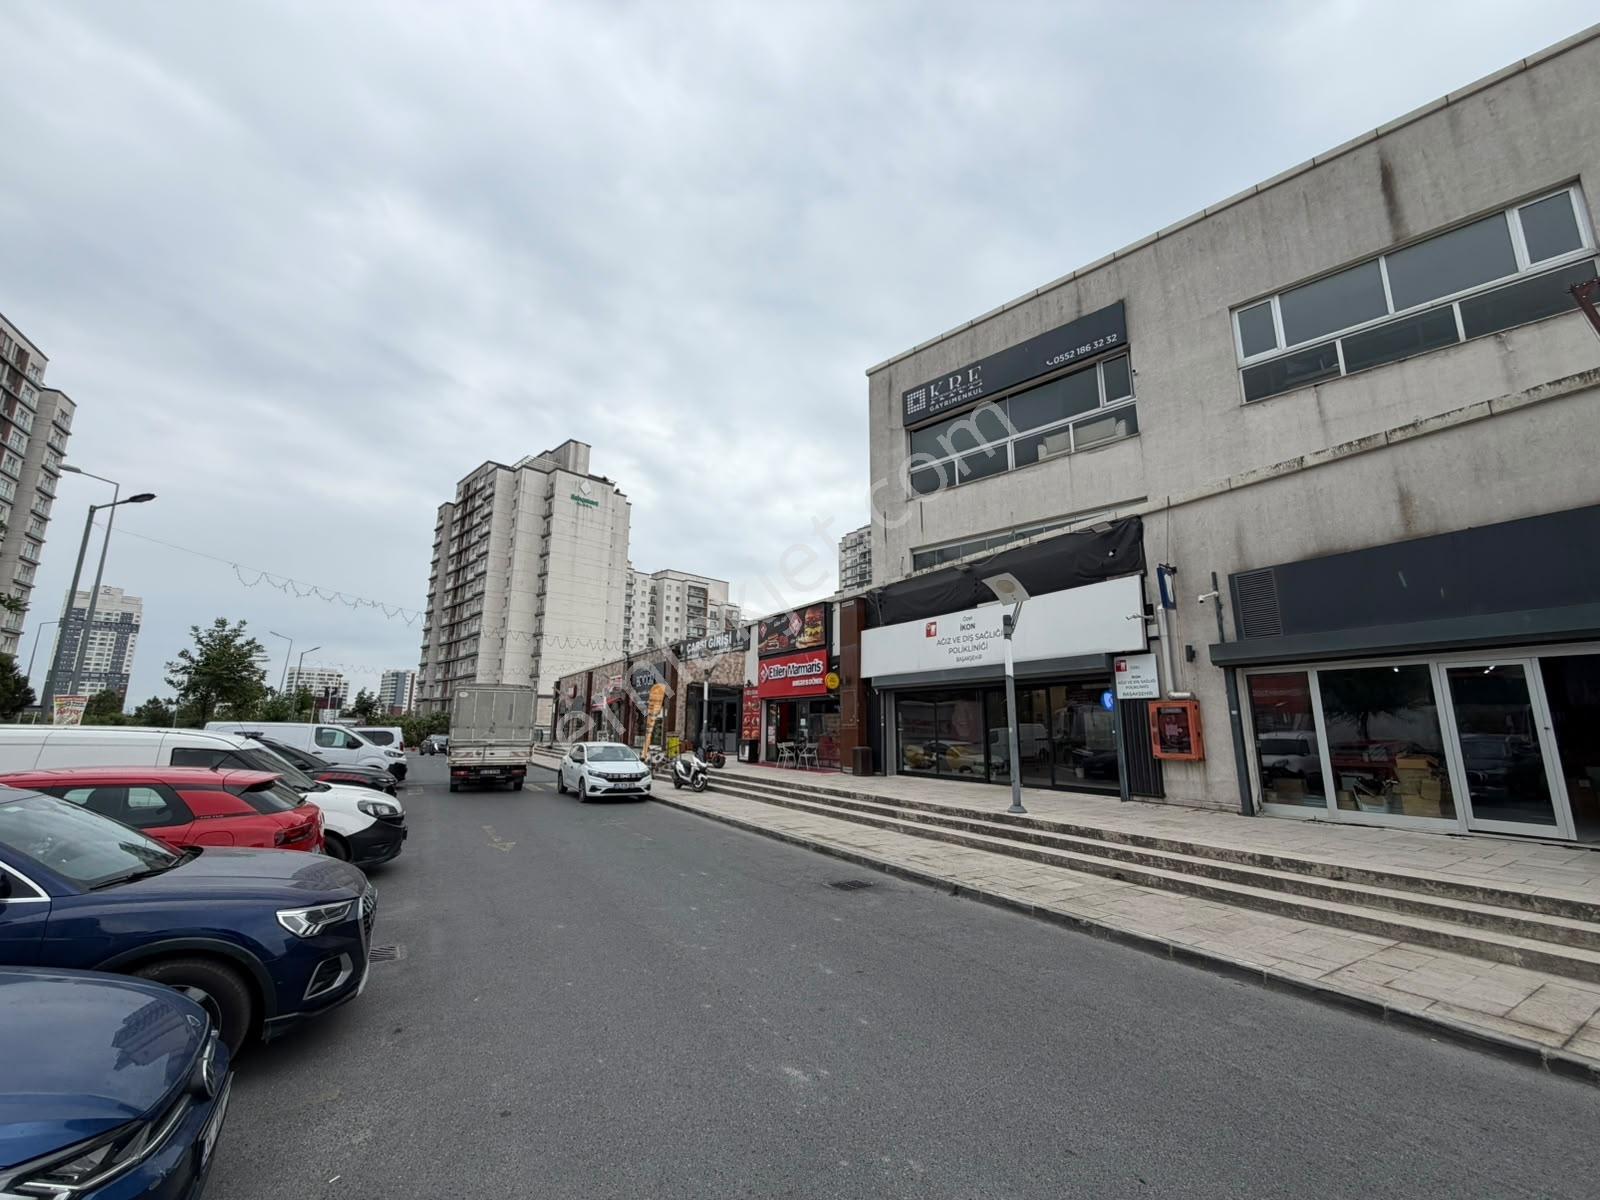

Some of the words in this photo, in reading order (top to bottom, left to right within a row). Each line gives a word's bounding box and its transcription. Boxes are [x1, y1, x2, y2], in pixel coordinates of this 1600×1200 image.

[1053, 350, 1075, 364] 0552
[1076, 343, 1092, 356] 186
[1093, 338, 1105, 349] 32
[1105, 333, 1118, 345] 32
[929, 365, 984, 406] KRE
[952, 635, 961, 644] VE
[787, 658, 824, 678] Marmaris
